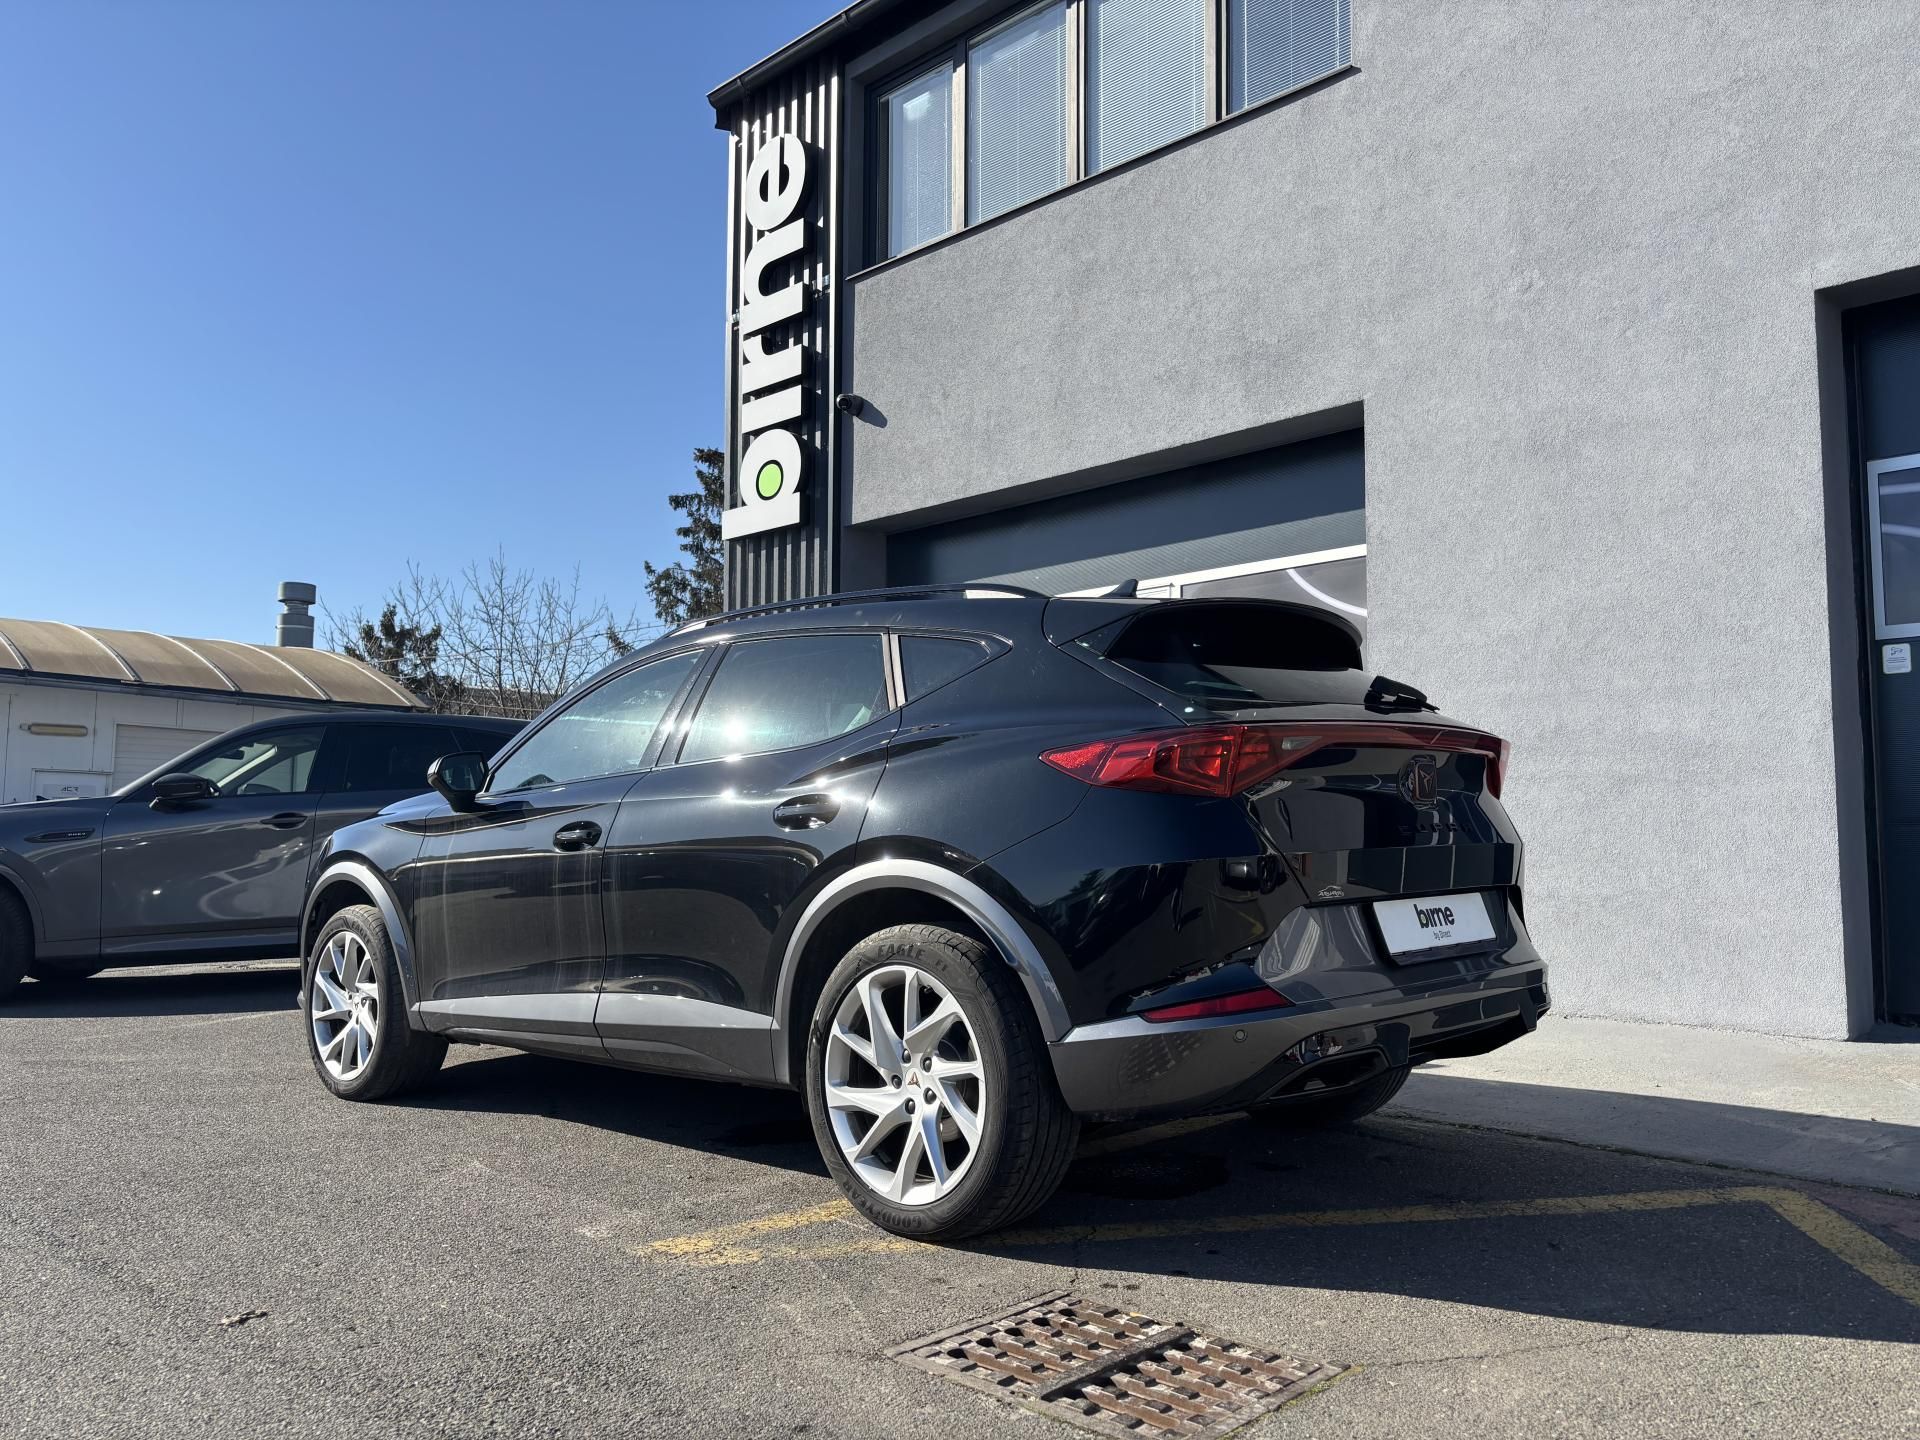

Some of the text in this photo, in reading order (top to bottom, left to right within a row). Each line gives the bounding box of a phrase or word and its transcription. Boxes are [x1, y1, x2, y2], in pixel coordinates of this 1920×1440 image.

[721, 133, 806, 541] birne
[1413, 904, 1455, 928] birne
[878, 943, 926, 961] EAGLE
